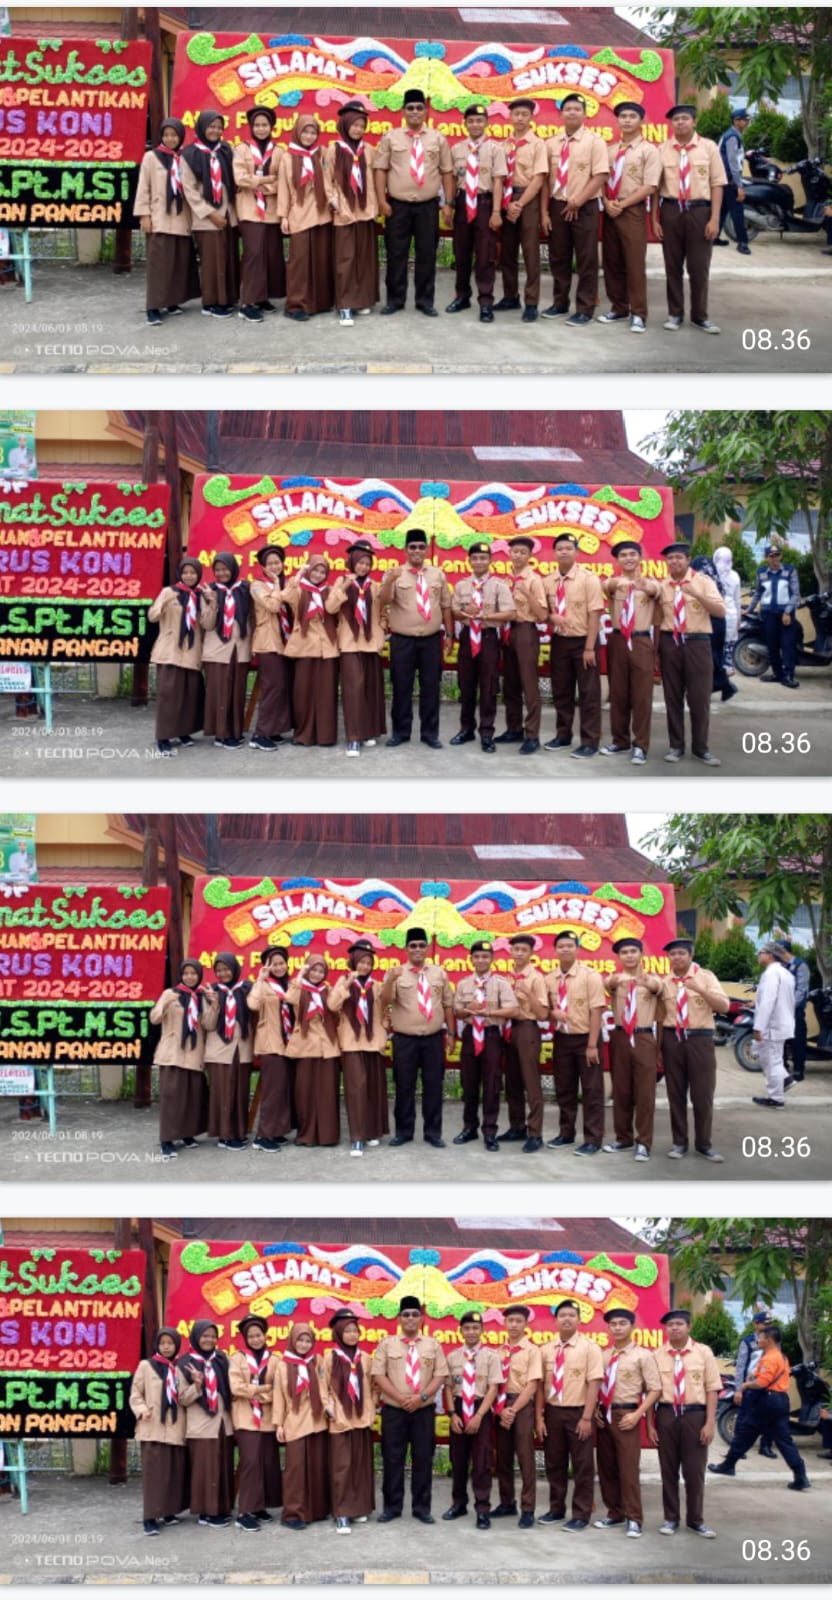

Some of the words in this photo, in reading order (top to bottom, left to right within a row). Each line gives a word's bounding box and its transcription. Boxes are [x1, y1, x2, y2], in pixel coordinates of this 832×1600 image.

[238, 51, 355, 89] SELAMAT
[512, 62, 617, 97] SUKSES
[37, 111, 112, 136] KONI
[0, 138, 123, 159] 2024-2028
[30, 201, 122, 223] PANGAN
[252, 491, 363, 529] SELAMAT
[515, 500, 618, 534] SUKSES
[60, 551, 131, 575] KONI
[21, 576, 141, 596] 2024-2028
[52, 637, 139, 657] PANGAN
[252, 893, 364, 929] SELAMAT
[516, 898, 619, 931] SUKSES
[62, 953, 133, 977] KONI
[23, 979, 143, 999] 2024-2028
[54, 1038, 141, 1060] PANGAN
[232, 1259, 350, 1297] SELAMAT
[508, 1268, 612, 1302] SUKSES
[31, 1321, 106, 1346] KONI
[25, 1411, 117, 1433] PANGAN
